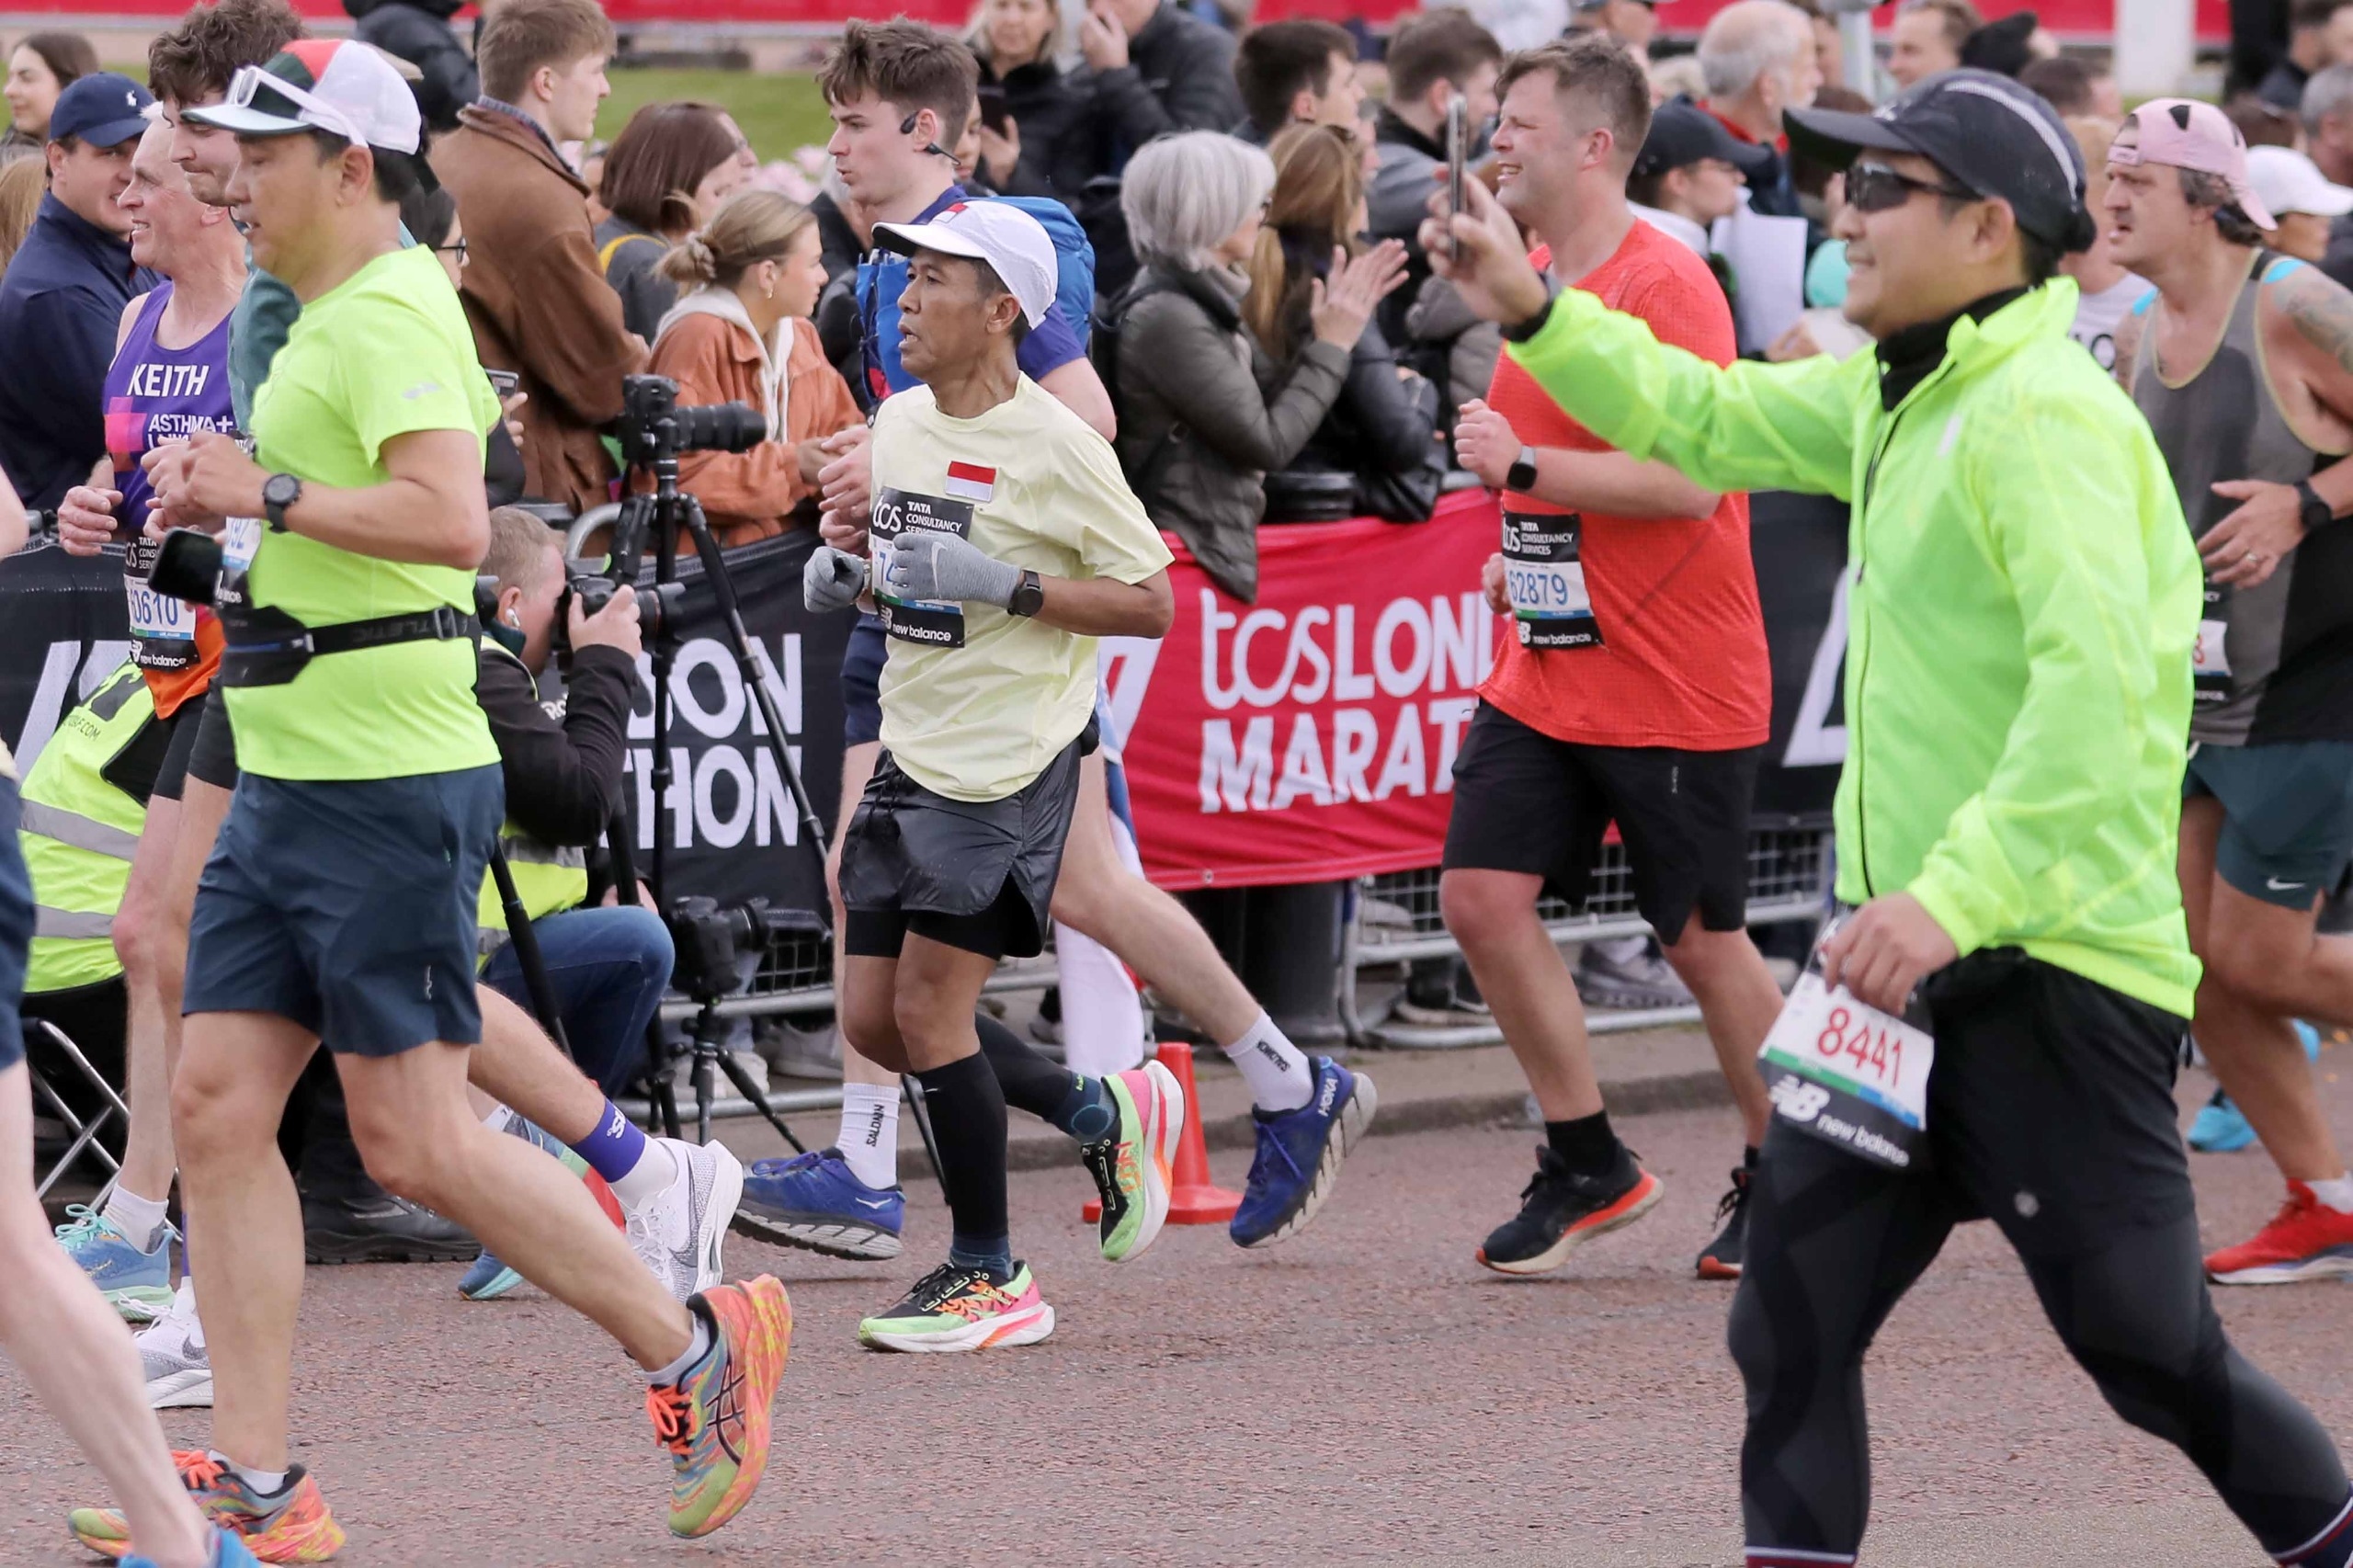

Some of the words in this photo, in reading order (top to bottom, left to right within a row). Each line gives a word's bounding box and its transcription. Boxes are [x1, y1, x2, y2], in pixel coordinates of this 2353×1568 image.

[127, 364, 210, 397] KEITH
[872, 495, 902, 532] tcs
[906, 501, 931, 515] TATA
[905, 513, 962, 533] CONSULTANCY
[1520, 521, 1540, 532] TATA
[1520, 532, 1574, 545] CONSULTANCY
[139, 548, 157, 559] CONS
[1521, 545, 1552, 555] SERVICES
[1509, 571, 1569, 606] 62879
[129, 588, 179, 627] 0610
[892, 623, 908, 635] new
[909, 625, 952, 642] balance
[1551, 633, 1592, 645] balance
[152, 654, 187, 666] balance
[622, 745, 802, 849] HON
[1818, 1007, 1902, 1088] 8441
[1317, 1077, 1339, 1118] HOKA
[1816, 1113, 1857, 1142] new
[1854, 1125, 1910, 1166] balance
